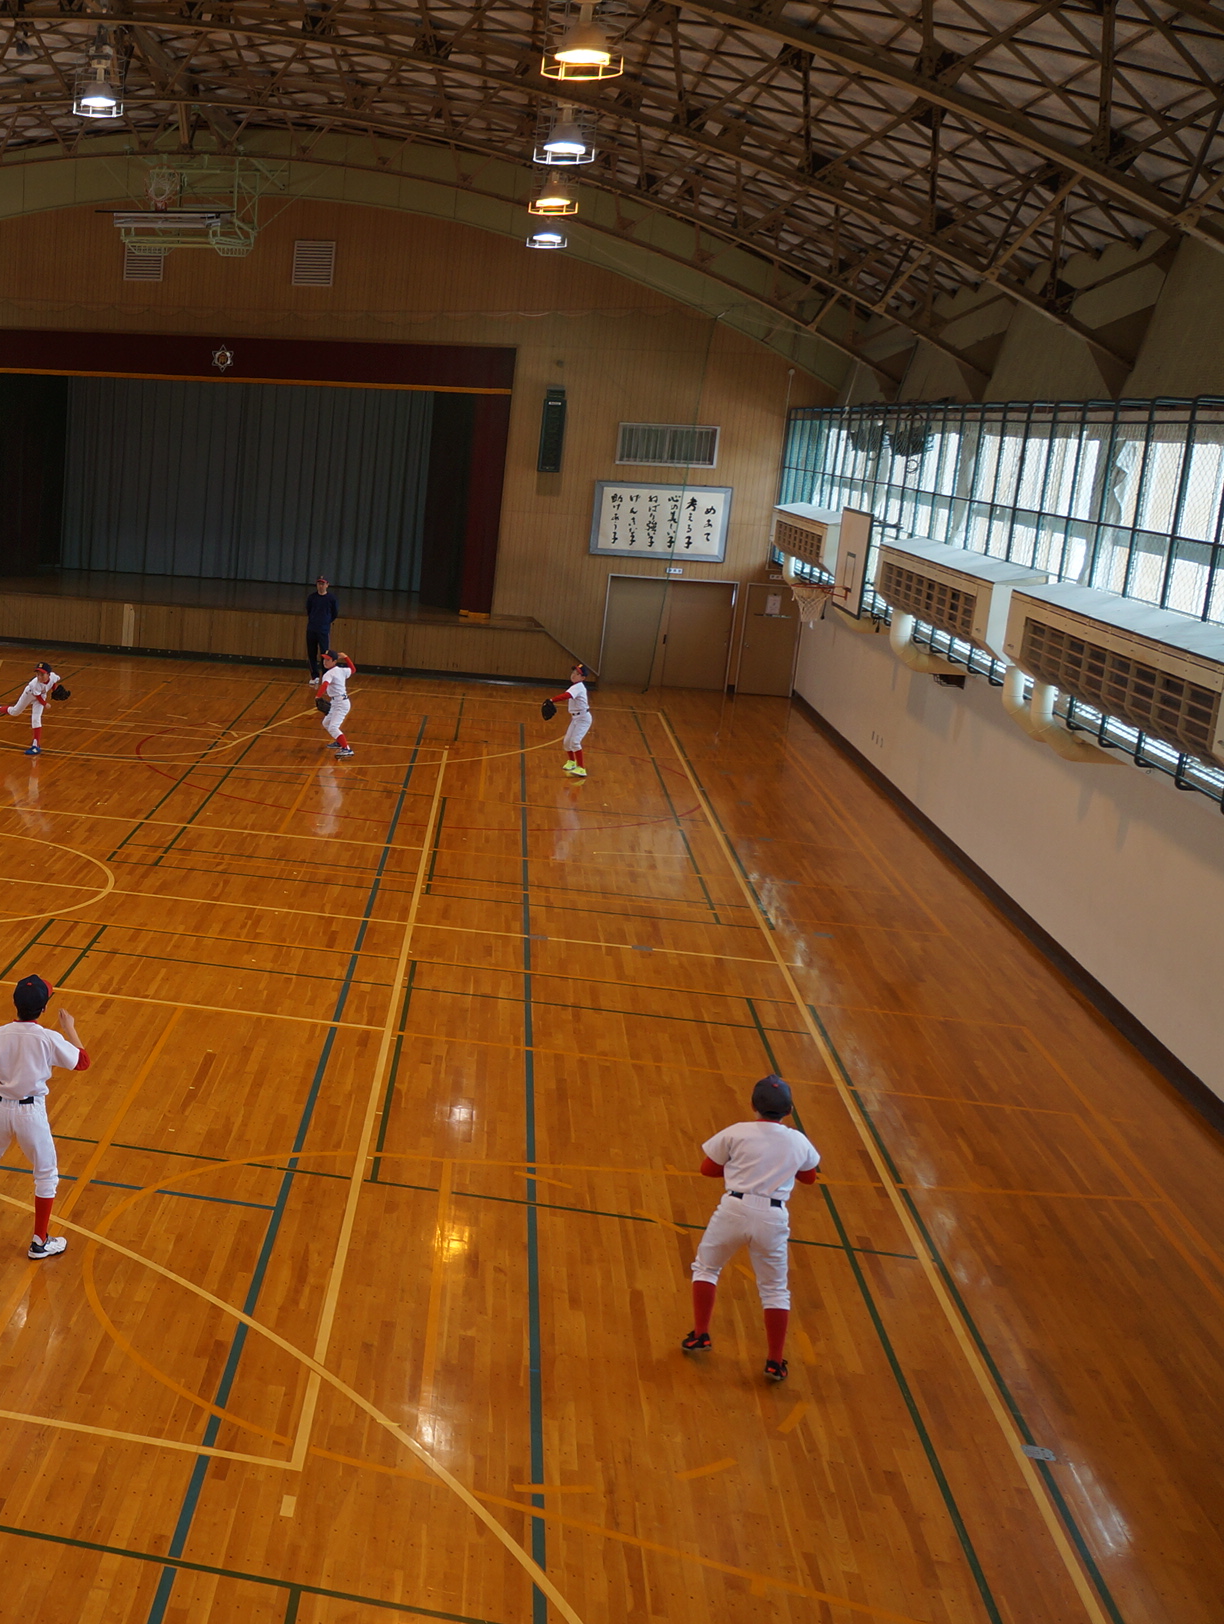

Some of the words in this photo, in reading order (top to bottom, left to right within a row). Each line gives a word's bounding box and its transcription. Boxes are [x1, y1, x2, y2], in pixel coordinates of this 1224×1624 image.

[628, 495, 640, 545] げんきな子
[646, 495, 659, 547] ねばり強い子
[667, 495, 680, 548] 心の美しい子
[684, 497, 698, 548] 考える子
[704, 506, 716, 542] めあて
